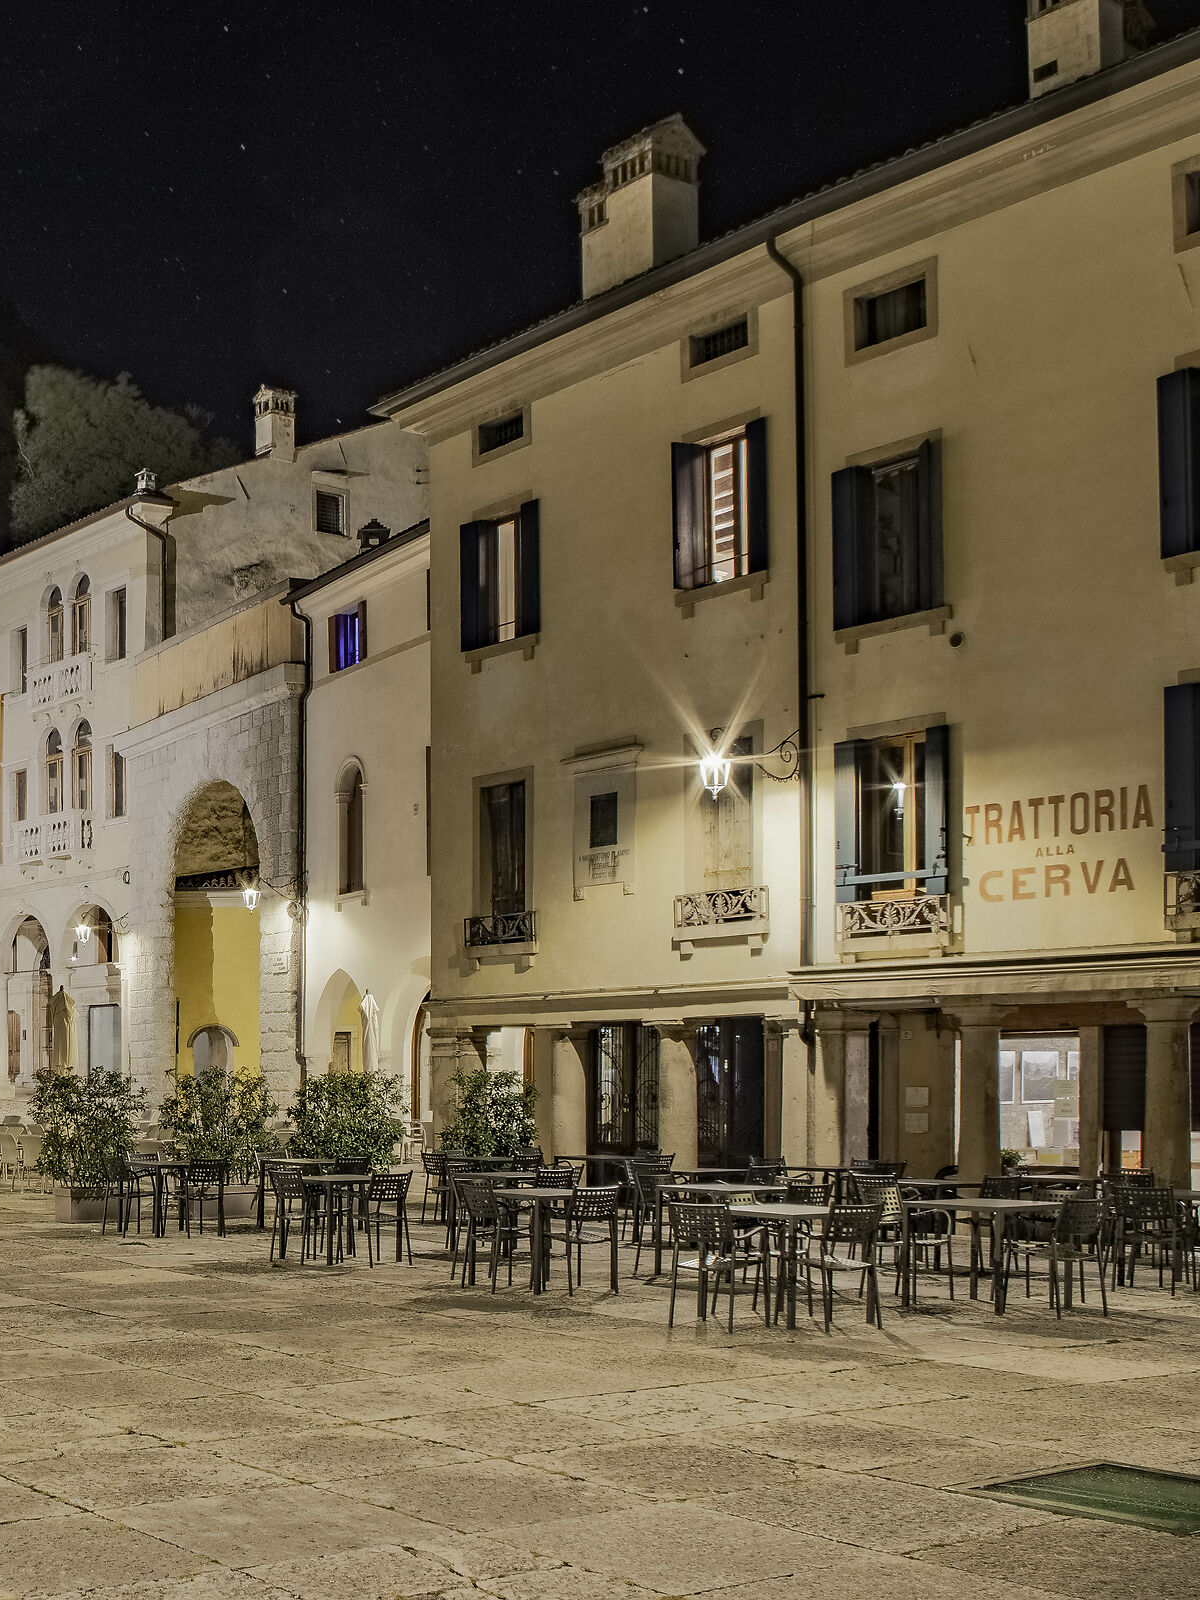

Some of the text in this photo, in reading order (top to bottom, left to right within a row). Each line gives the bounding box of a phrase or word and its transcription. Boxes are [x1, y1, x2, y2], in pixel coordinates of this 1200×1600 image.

[965, 784, 1154, 847] TRATTORIA
[1035, 844, 1075, 858] ALLA
[979, 858, 1135, 903] CERVA
